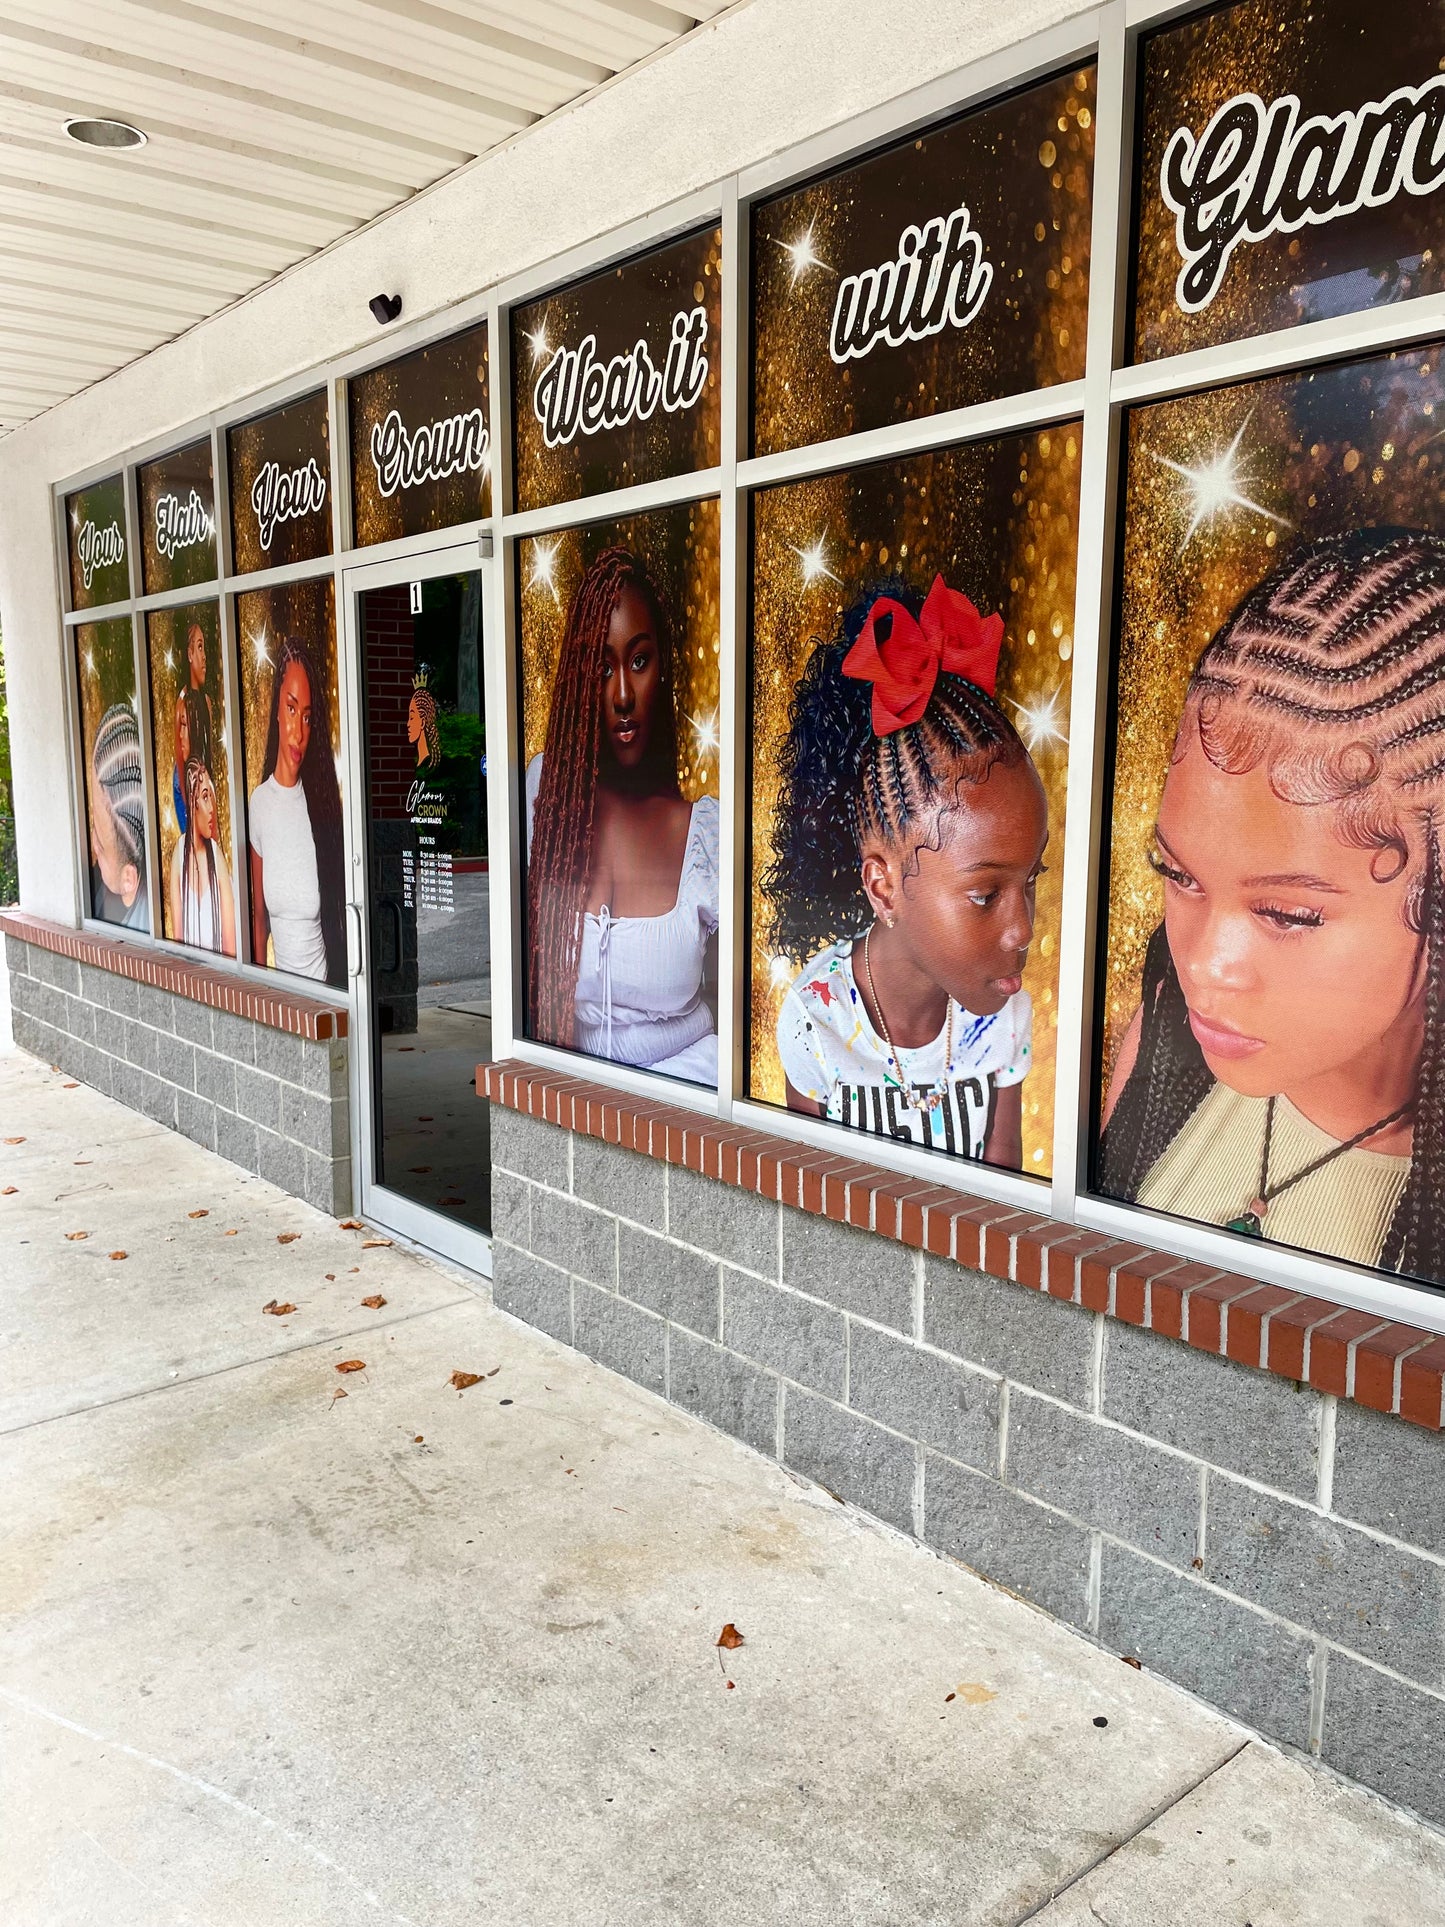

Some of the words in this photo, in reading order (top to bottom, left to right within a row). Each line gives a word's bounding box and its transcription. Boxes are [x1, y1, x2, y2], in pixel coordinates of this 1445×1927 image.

[78, 520, 124, 590] Your
[155, 489, 209, 560] Hair
[252, 457, 326, 551] Your
[371, 408, 489, 498] Crown
[534, 334, 662, 448] Wear
[662, 306, 708, 413] it
[830, 207, 994, 364] with
[1160, 73, 1445, 314] Glam
[413, 584, 419, 611] 1
[405, 779, 445, 812] Glamour
[410, 816, 428, 824] AFRICAN
[428, 817, 442, 825] BRAIDS
[417, 804, 448, 817] CROWN
[419, 836, 436, 845] HOURS
